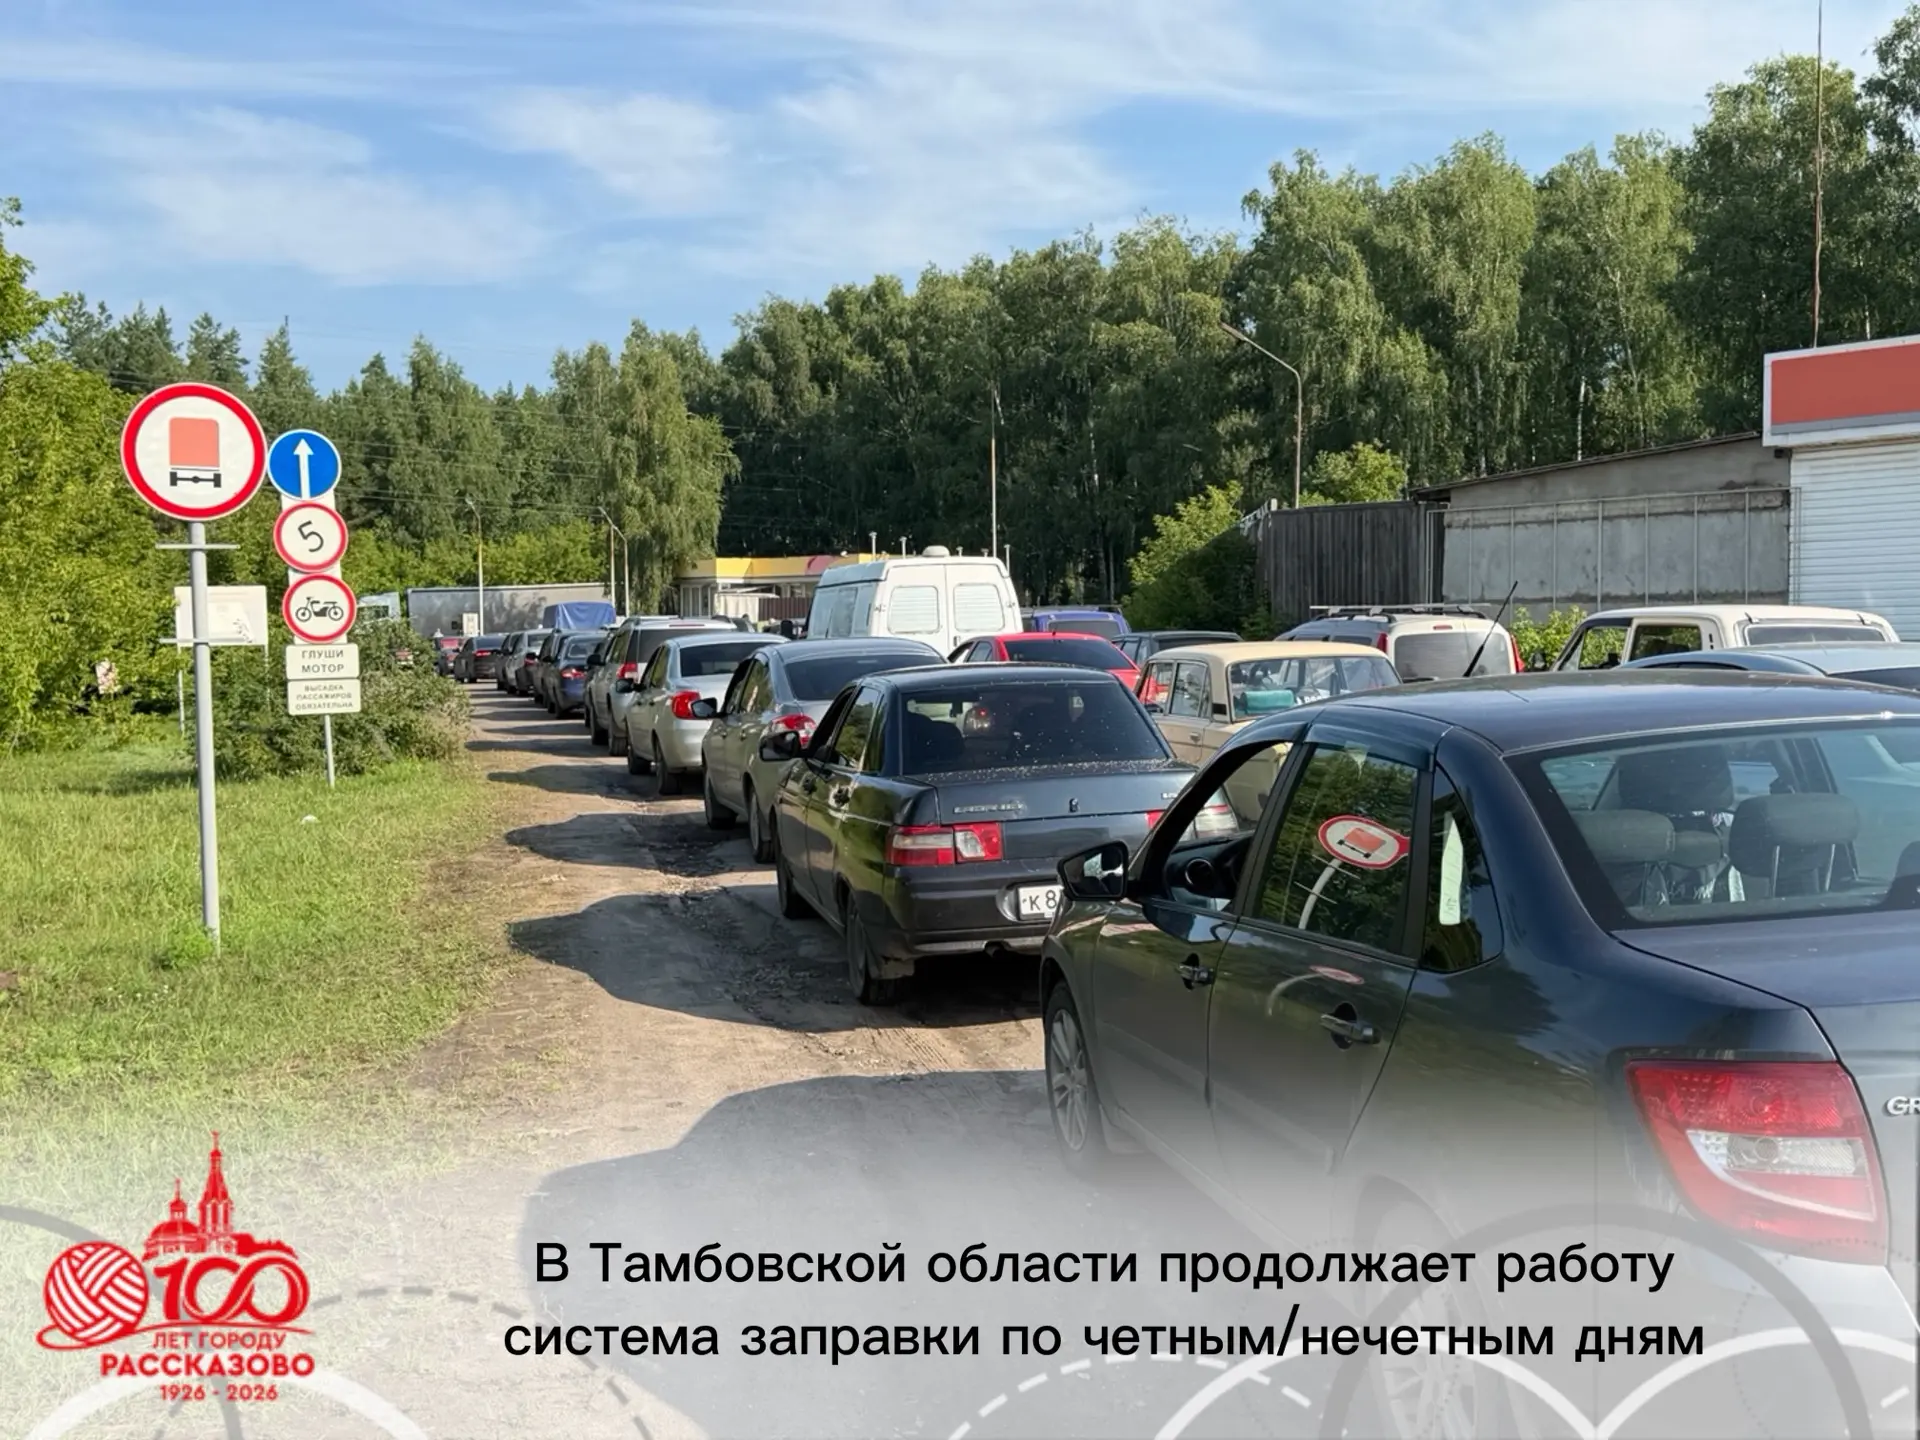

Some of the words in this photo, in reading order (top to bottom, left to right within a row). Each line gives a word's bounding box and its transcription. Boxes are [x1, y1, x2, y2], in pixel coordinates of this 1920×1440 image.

[297, 520, 324, 552] 5
[301, 650, 344, 659] ГЛУШИ
[301, 663, 345, 673] МОТОР
[304, 684, 344, 692] ВЫСАДКА
[296, 692, 352, 701] ПАССАЖИРОВ
[295, 702, 354, 711] ОБЯЗАТЕЛЬНА
